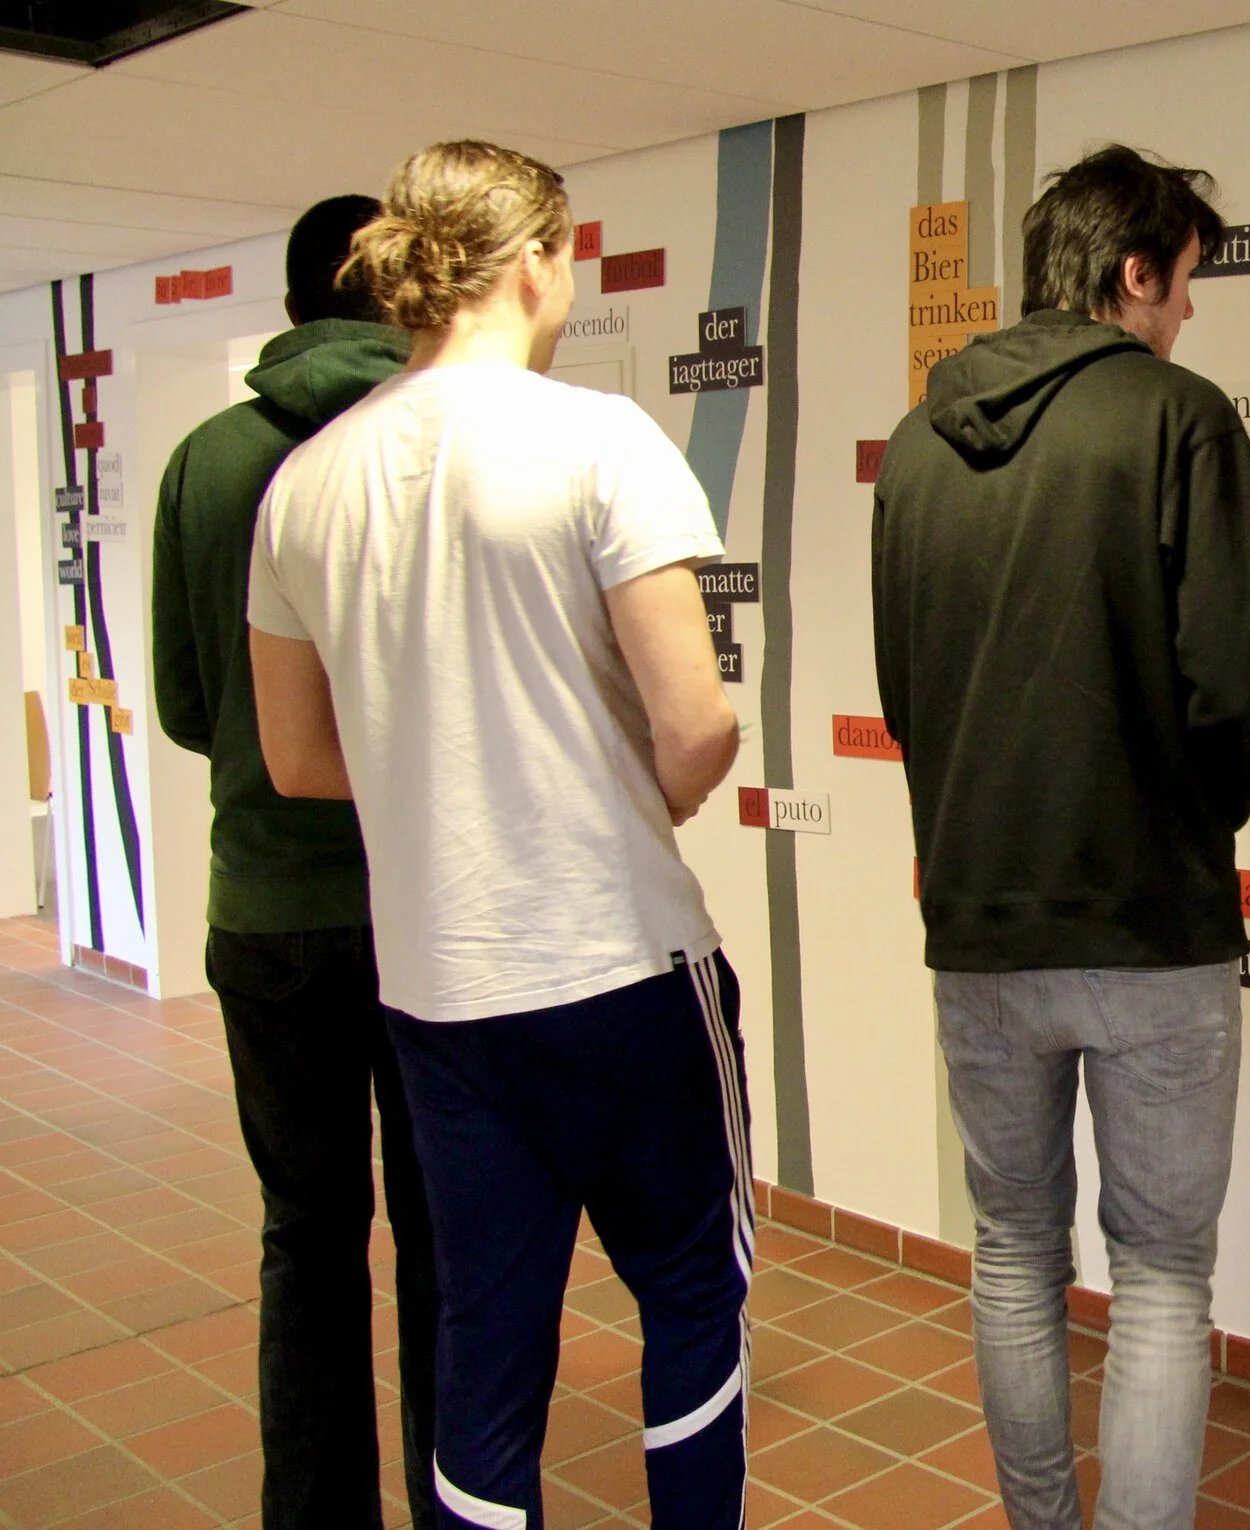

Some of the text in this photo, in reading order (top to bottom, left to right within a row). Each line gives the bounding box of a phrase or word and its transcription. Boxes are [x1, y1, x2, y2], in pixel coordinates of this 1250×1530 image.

[918, 206, 957, 238] das
[578, 225, 594, 251] la
[913, 250, 964, 283] Bier
[559, 308, 625, 338] ocendo
[909, 292, 998, 327] trinken
[705, 312, 738, 341] der
[673, 357, 759, 392] iagttager
[698, 570, 754, 593] matte
[838, 717, 901, 750] dano
[745, 790, 761, 818] el
[774, 800, 822, 828] puto
